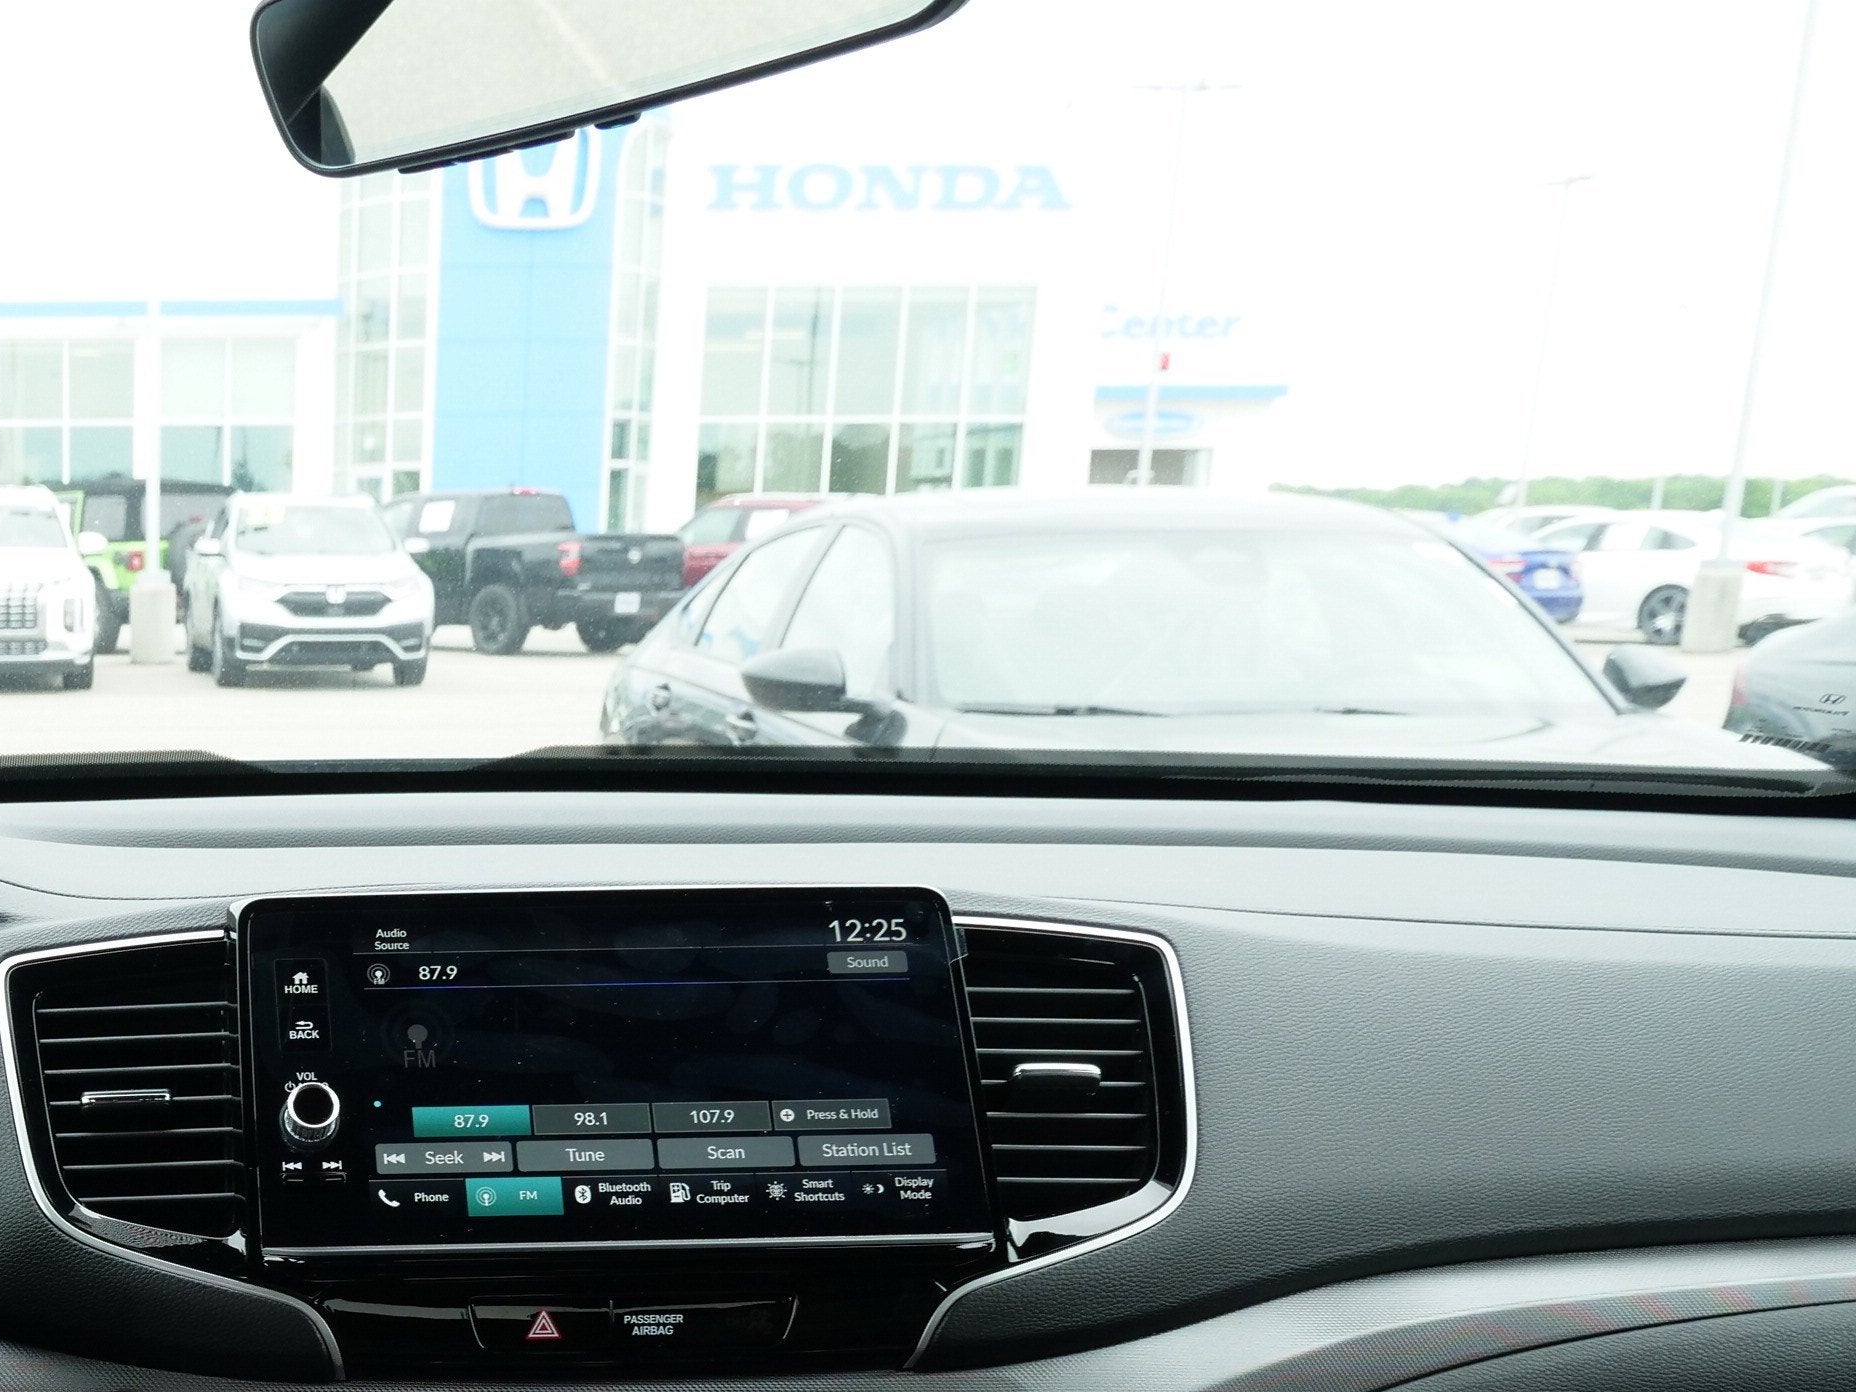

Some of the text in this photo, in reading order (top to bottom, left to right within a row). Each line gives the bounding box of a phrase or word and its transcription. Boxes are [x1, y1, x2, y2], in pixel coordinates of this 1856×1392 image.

[705, 163, 1072, 212] HONDA
[375, 928, 407, 939] Audio
[828, 918, 907, 942] 12:25
[374, 940, 409, 950] Source
[846, 956, 889, 968] Sound
[418, 965, 458, 981] 87.9
[284, 985, 318, 994] HOME
[289, 1029, 320, 1040] BACK
[296, 1072, 318, 1081] VOL
[574, 1112, 608, 1126] 98.1
[689, 1109, 735, 1124] 107.9
[806, 1108, 878, 1120] Press & Hold
[453, 1114, 489, 1129] 87.9
[565, 1148, 605, 1163] Tune
[707, 1146, 745, 1160] Scan
[822, 1142, 912, 1157] Station List
[425, 1150, 464, 1165] Seek
[599, 1182, 651, 1193] Bluetooth
[711, 1180, 731, 1192] Trip
[802, 1178, 834, 1189] Smart
[894, 1177, 934, 1190] Display
[414, 1191, 450, 1203] Phone
[519, 1190, 538, 1200] FM
[610, 1195, 643, 1206] Audio
[696, 1193, 750, 1205] Computer
[794, 1191, 845, 1202] Shortcuts
[900, 1189, 932, 1200] Mode
[624, 1314, 684, 1324] PASSENGER
[632, 1325, 674, 1336] AIRBAG
